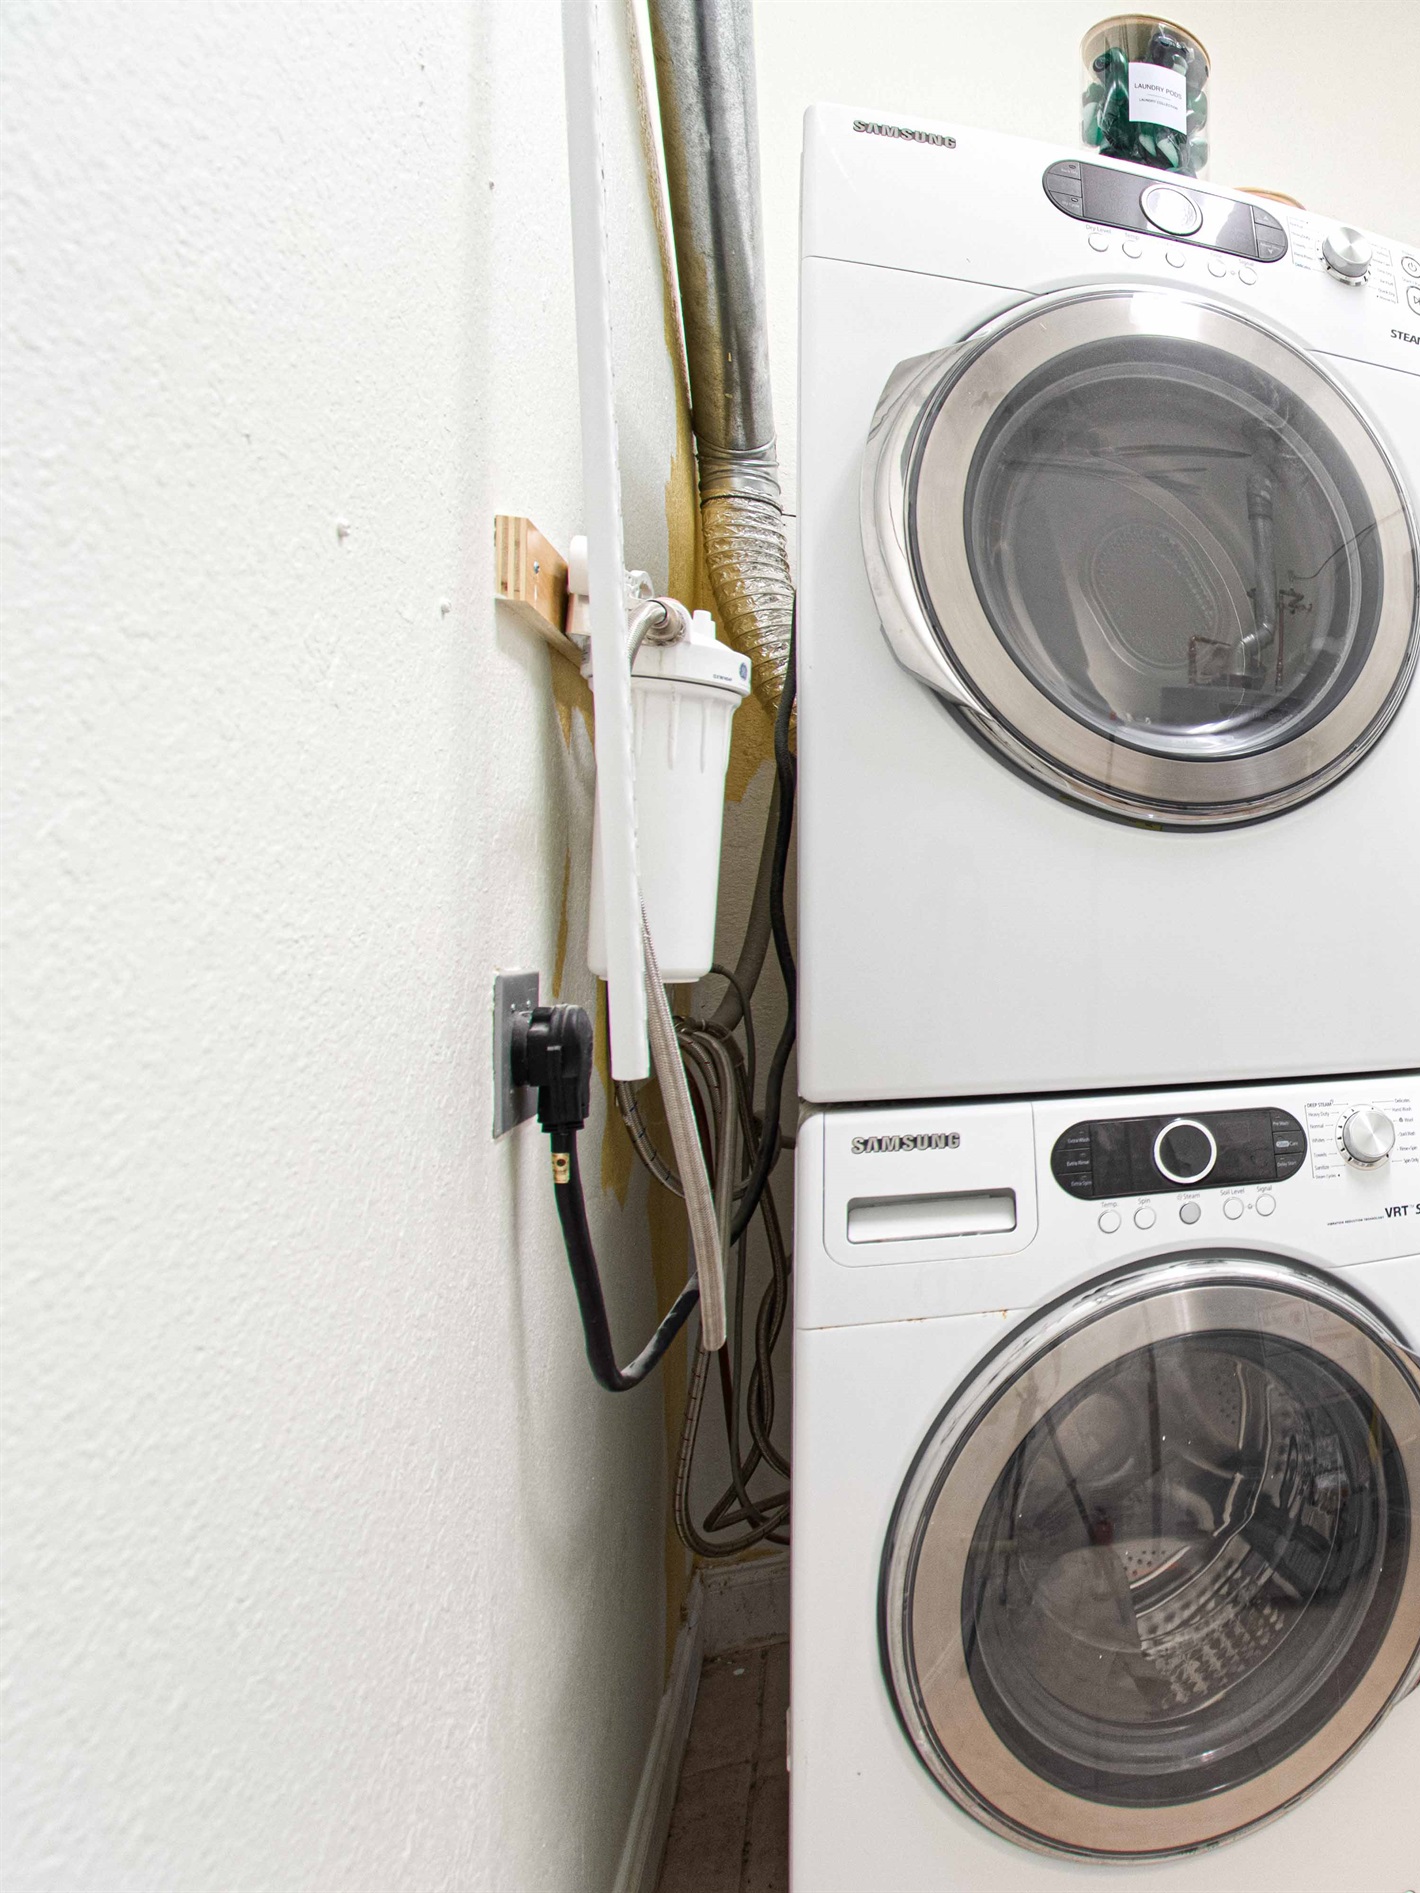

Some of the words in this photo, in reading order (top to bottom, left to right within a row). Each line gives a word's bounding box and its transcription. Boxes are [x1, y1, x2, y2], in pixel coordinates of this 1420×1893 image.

[1134, 83, 1164, 92] LAUNDRY
[1166, 88, 1182, 100] PODS
[853, 120, 956, 149] SAMSUNG
[851, 1132, 960, 1155] SAMSUNG
